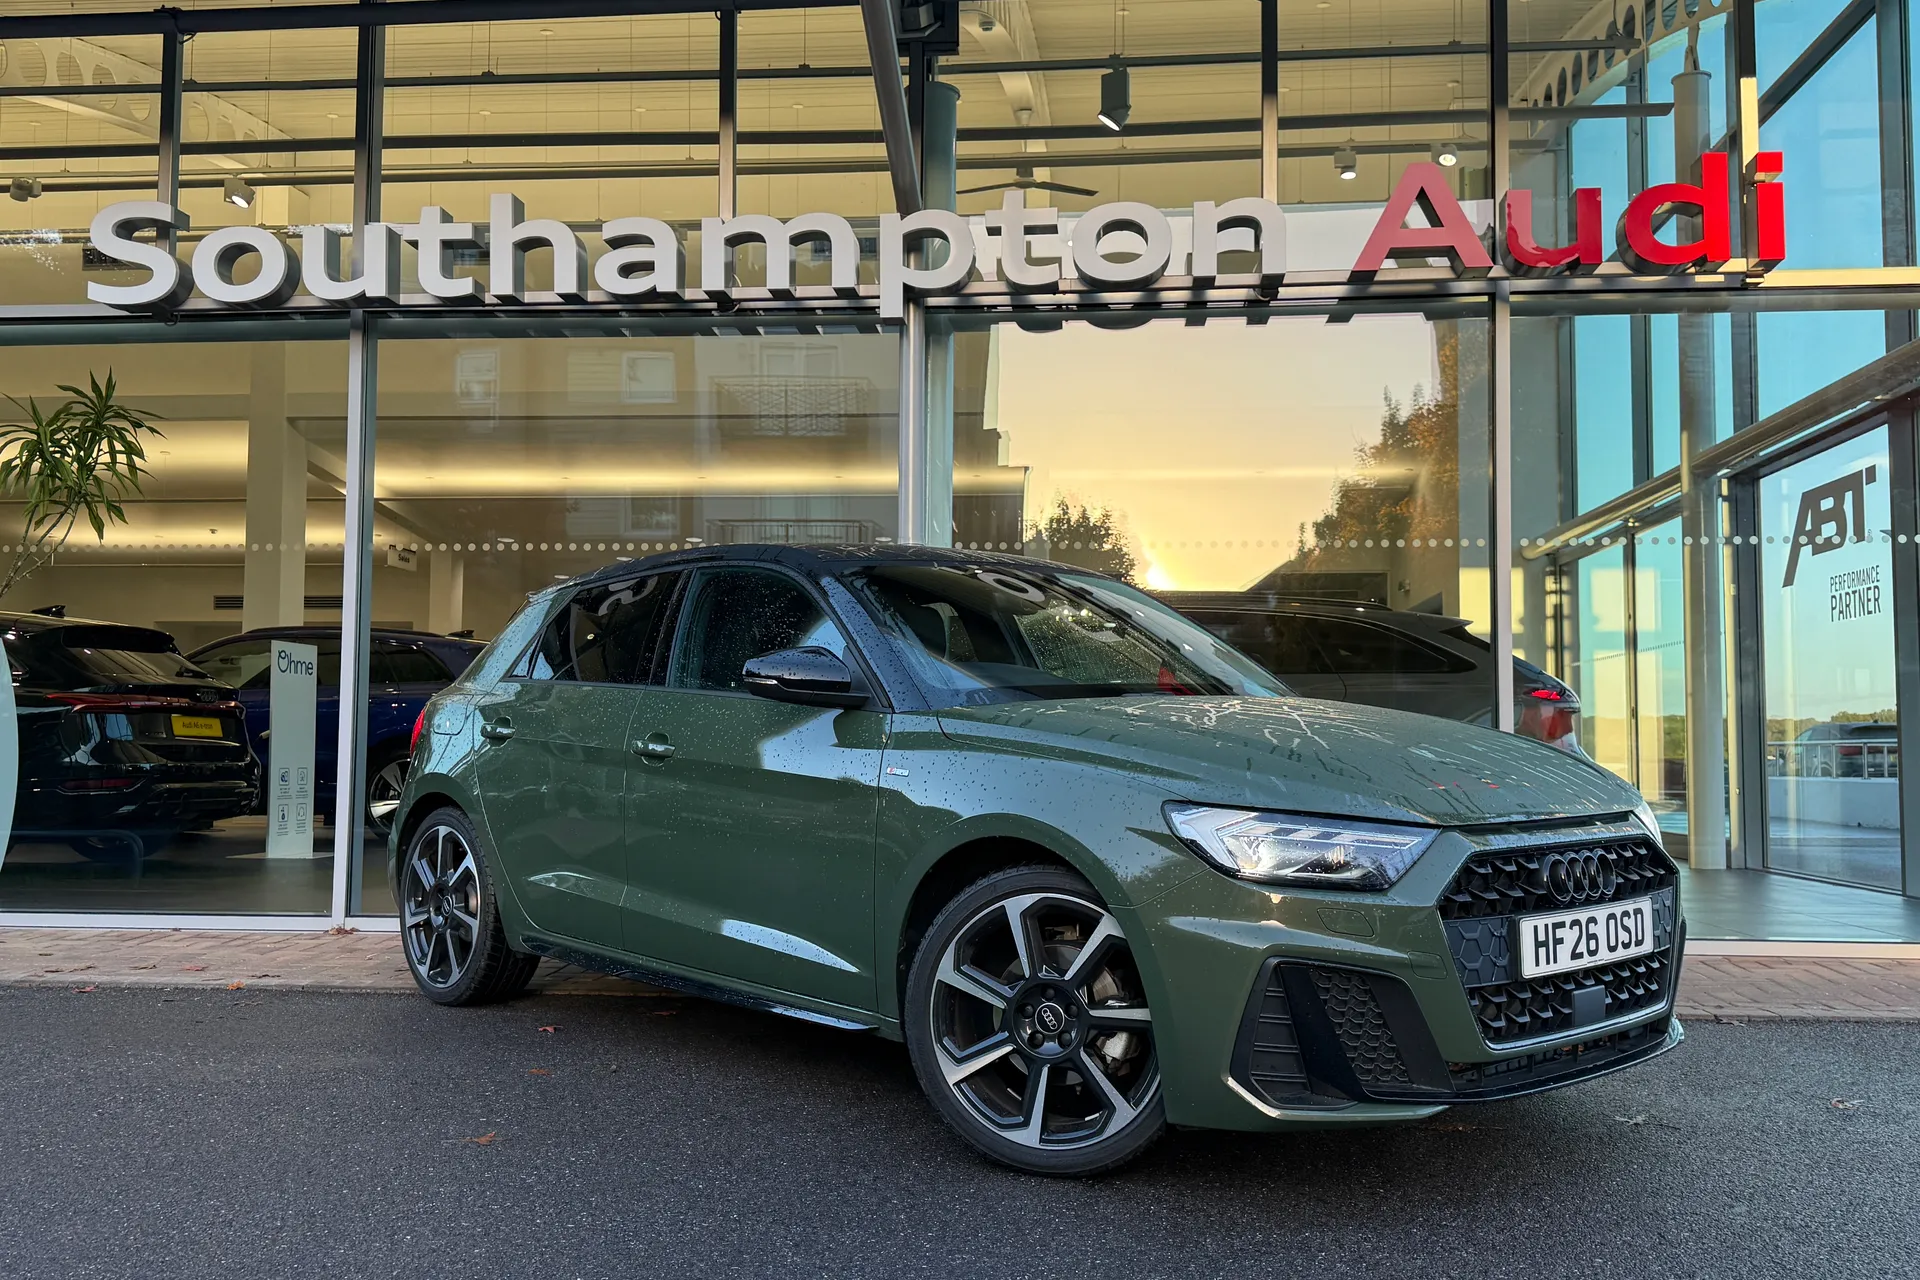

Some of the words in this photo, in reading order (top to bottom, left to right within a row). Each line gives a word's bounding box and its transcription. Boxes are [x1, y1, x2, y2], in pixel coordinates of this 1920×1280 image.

[87, 190, 1288, 320] Southampton
[1350, 151, 1785, 277] Audi
[1782, 464, 1876, 588] ABT
[1830, 565, 1880, 593] PERFORMANCE
[1830, 585, 1881, 622] PARTNER
[277, 649, 314, 676] Ohme
[1533, 916, 1600, 968] HF26
[1605, 907, 1645, 953] OSD
